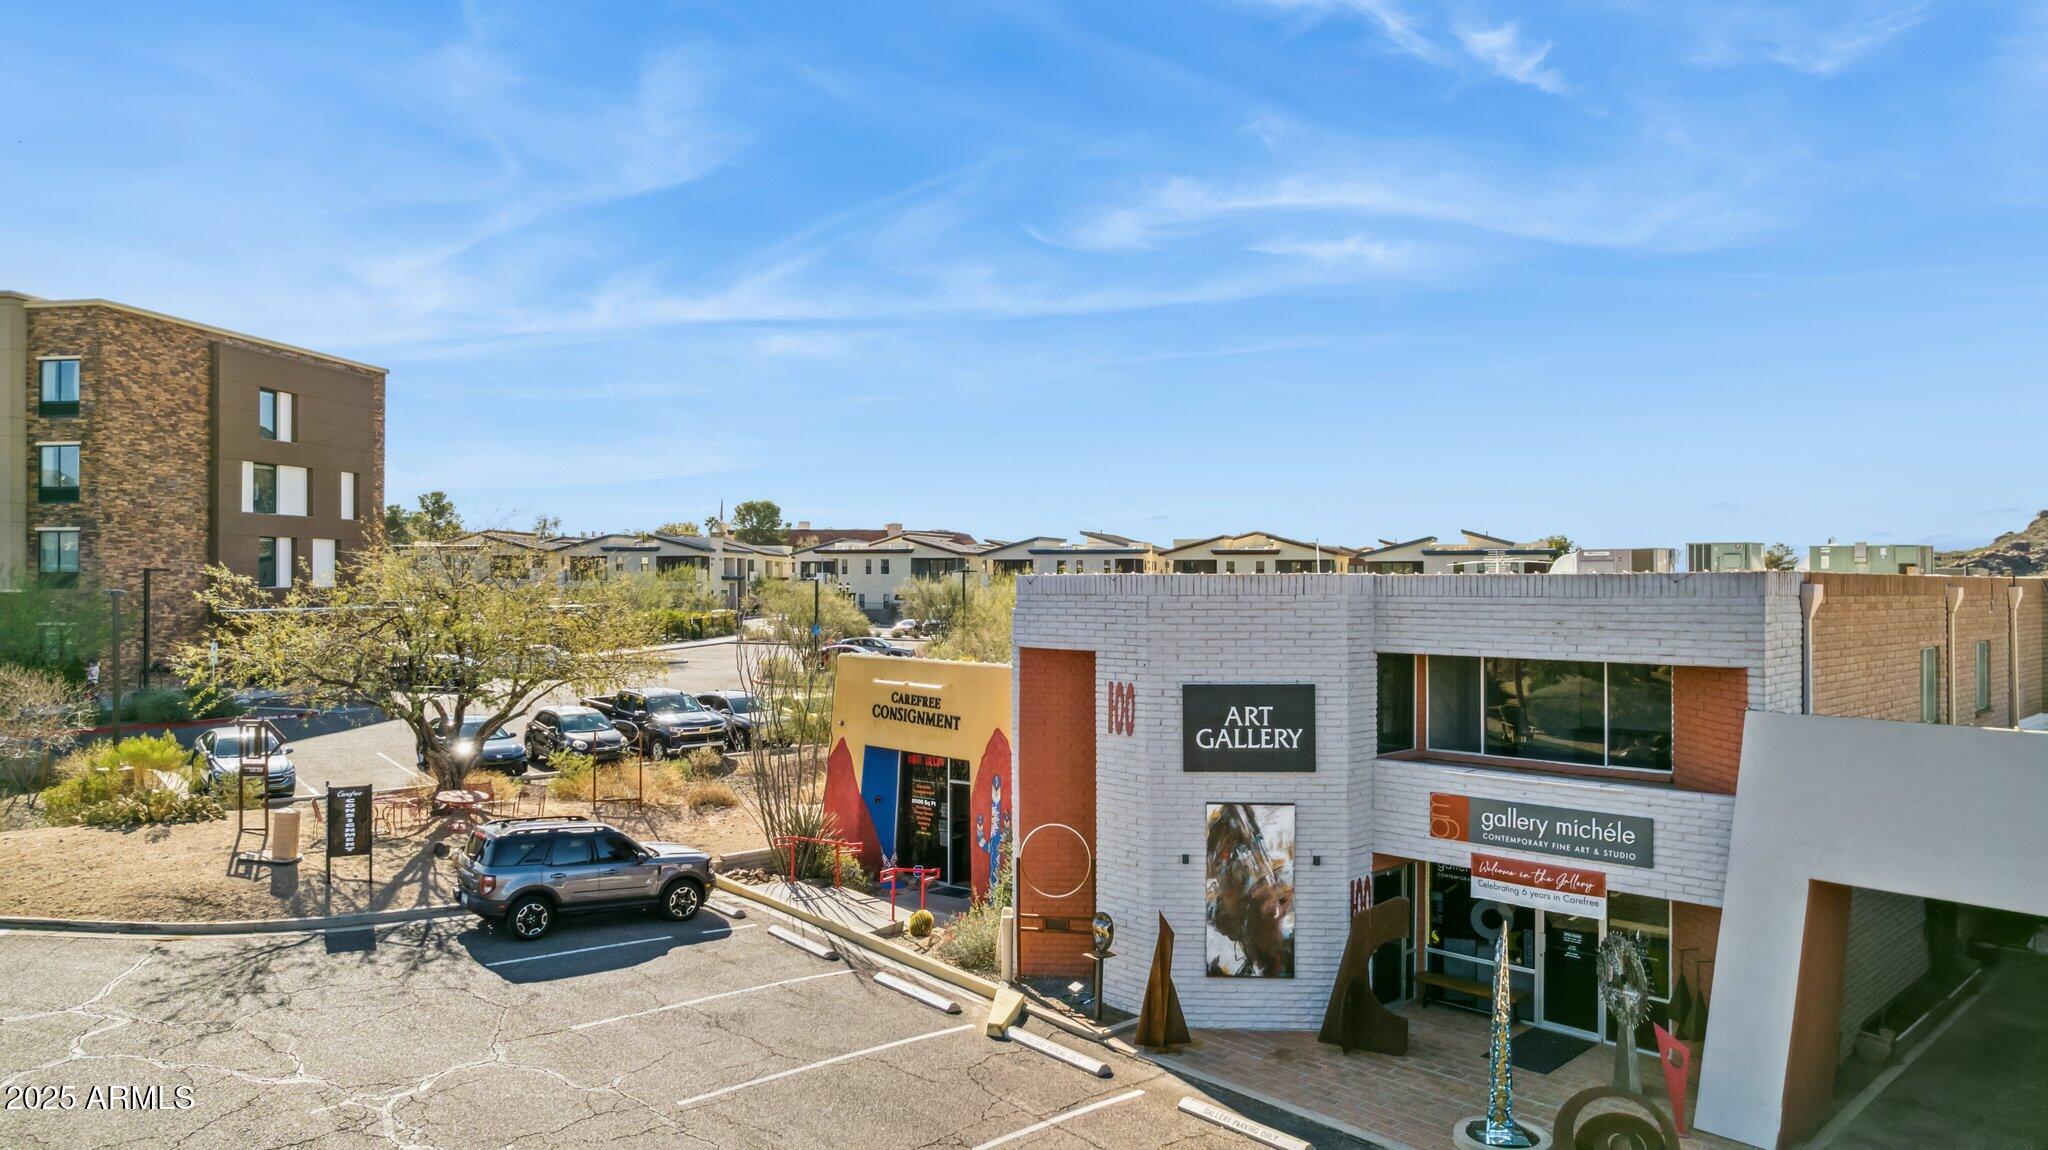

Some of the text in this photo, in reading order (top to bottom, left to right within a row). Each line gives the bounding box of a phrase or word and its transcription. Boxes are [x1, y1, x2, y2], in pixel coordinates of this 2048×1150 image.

[892, 692, 941, 709] CAREFREE
[1108, 681, 1135, 736] 100
[872, 704, 961, 730] CONSIGNMENT
[1224, 706, 1274, 726] ART
[1195, 728, 1303, 749] GALLERY
[337, 790, 363, 798] Carefree
[1481, 807, 1636, 845] gallery michéle
[1482, 832, 1549, 848] CONTEMPORARY
[1552, 842, 1571, 852] FINE
[1574, 845, 1590, 854] ART
[1603, 850, 1636, 861] STUDIO
[1478, 861, 1595, 893] Welcome in the Gallery
[1477, 879, 1600, 907] Celebrating 6 years in Carefree
[1203, 1107, 1280, 1142] GALLERY PARKING ONLY
